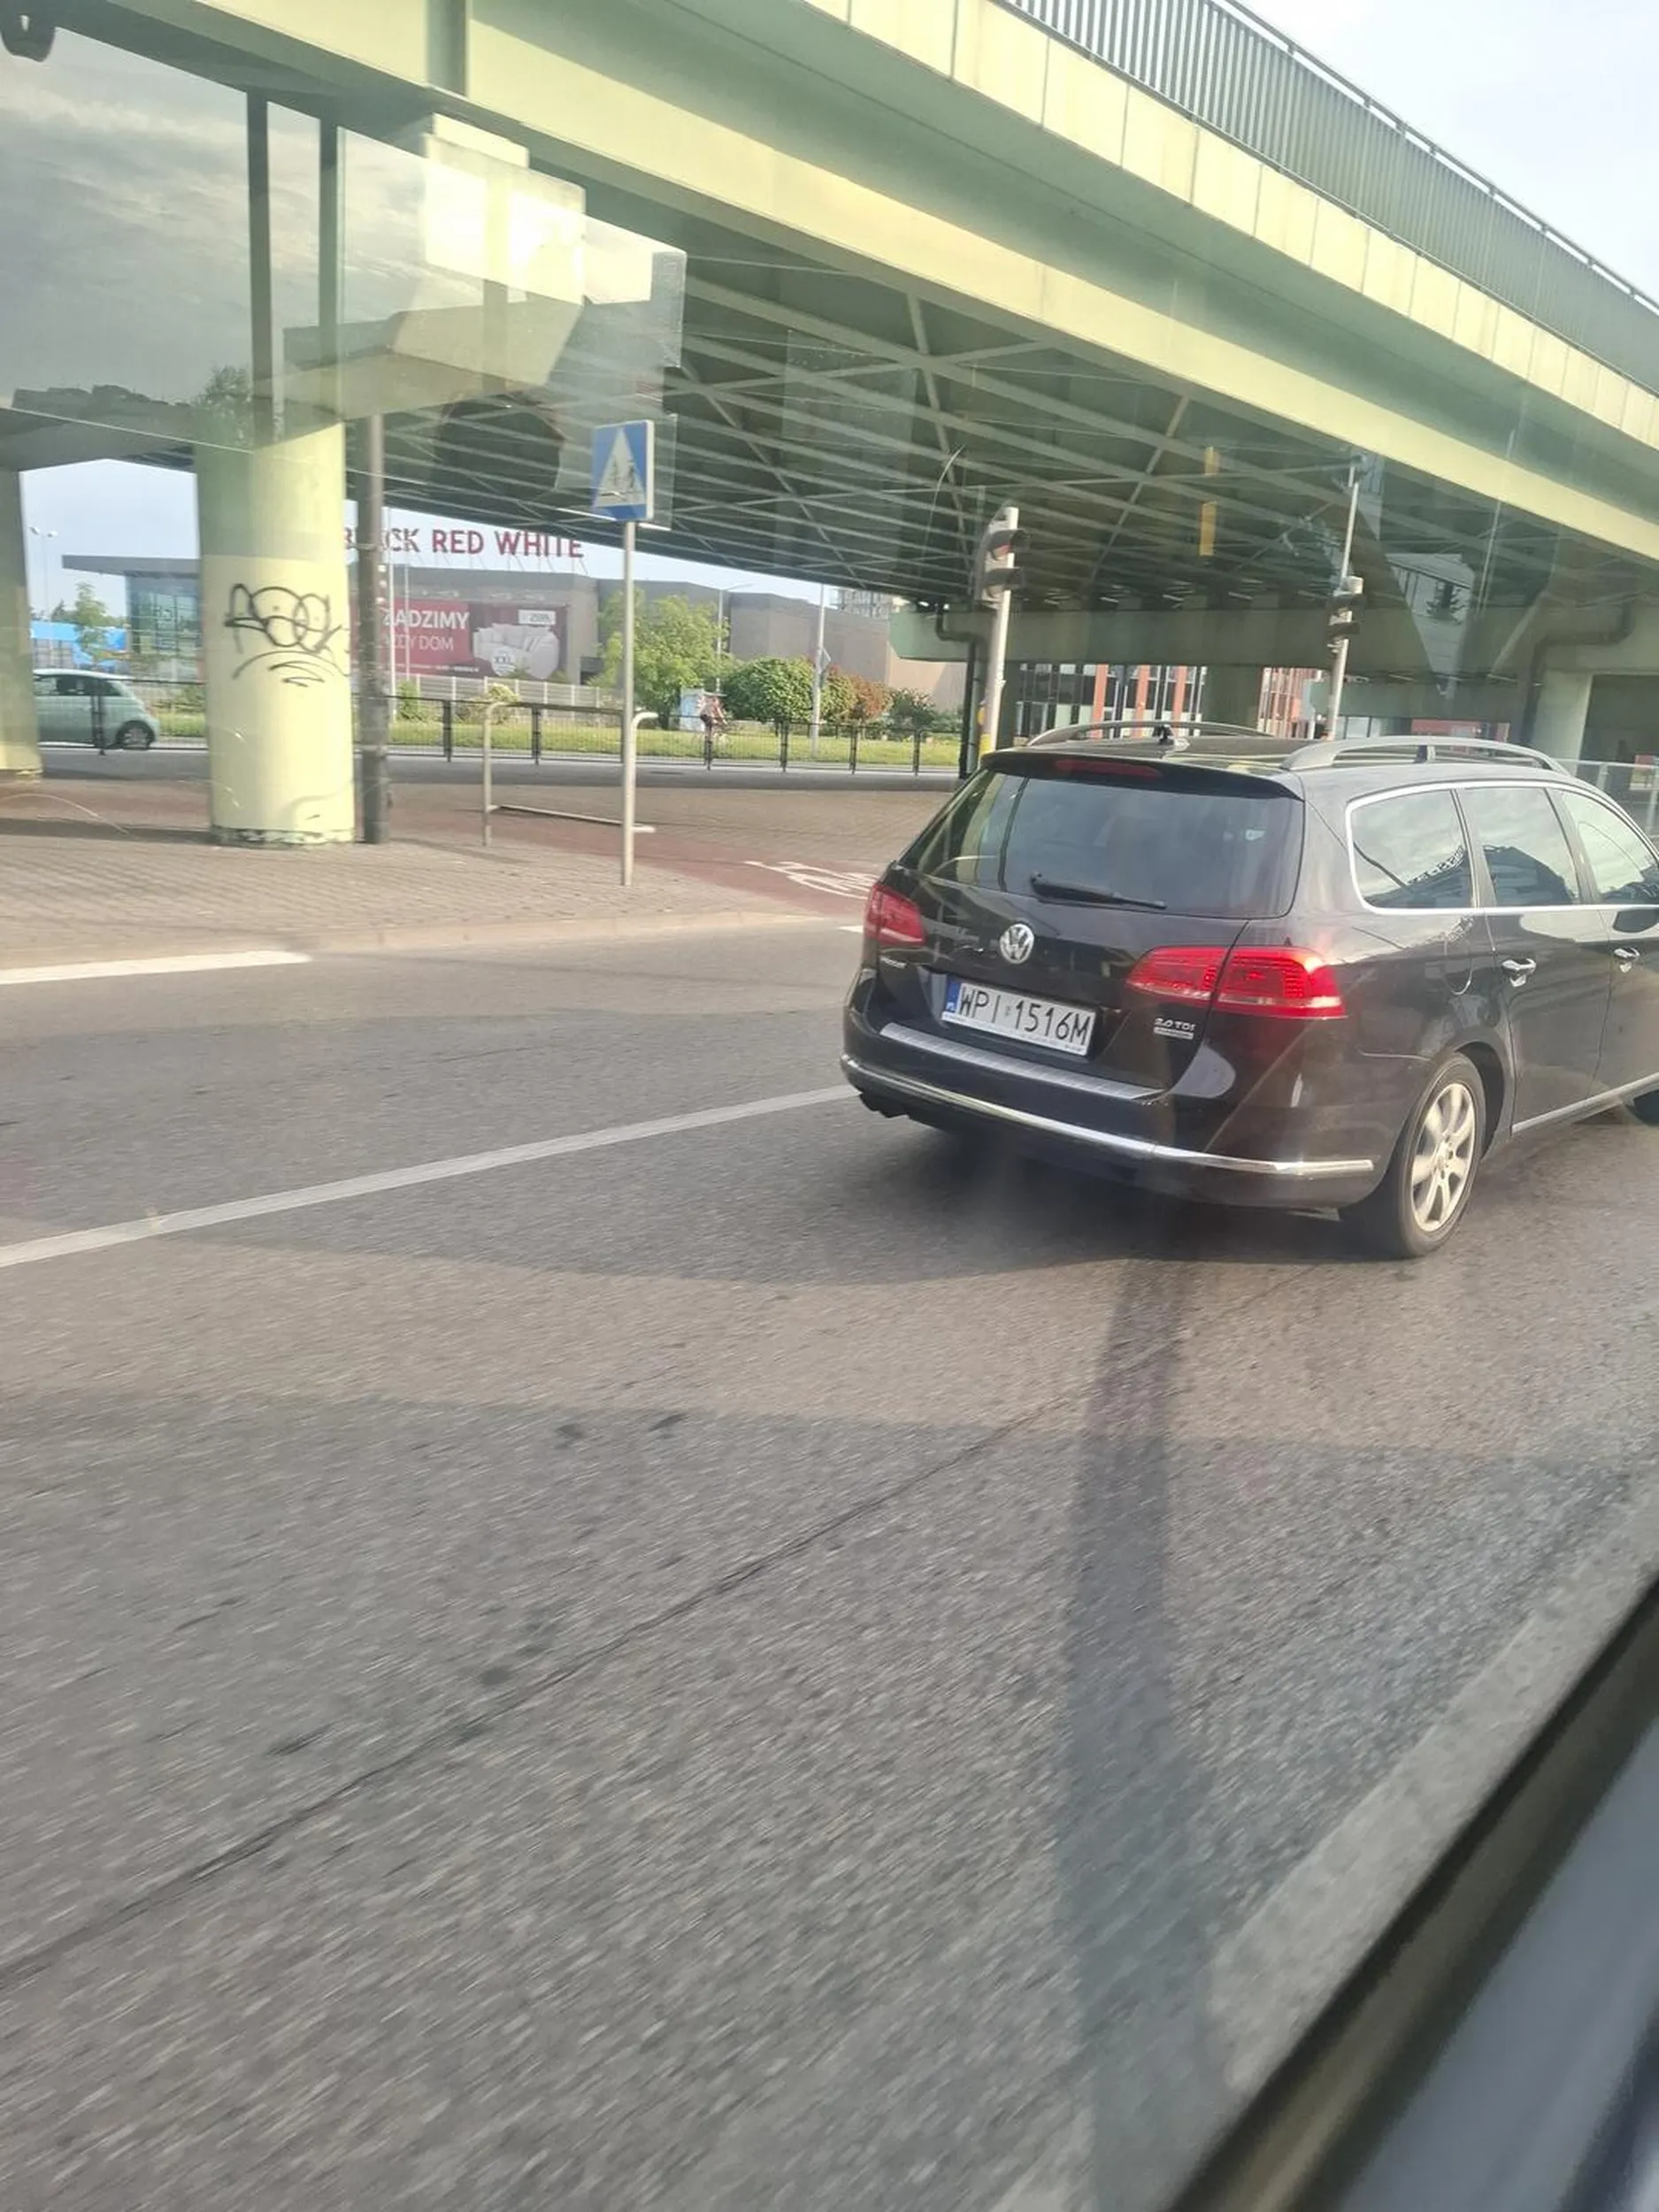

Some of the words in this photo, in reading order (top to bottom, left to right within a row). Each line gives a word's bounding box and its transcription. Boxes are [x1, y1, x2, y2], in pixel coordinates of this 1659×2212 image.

[432, 529, 484, 554] RED
[419, 635, 454, 652] DOM
[959, 985, 1002, 1024] WPI
[1015, 1000, 1092, 1047] 1516M
[1174, 1020, 1197, 1032] TDI
